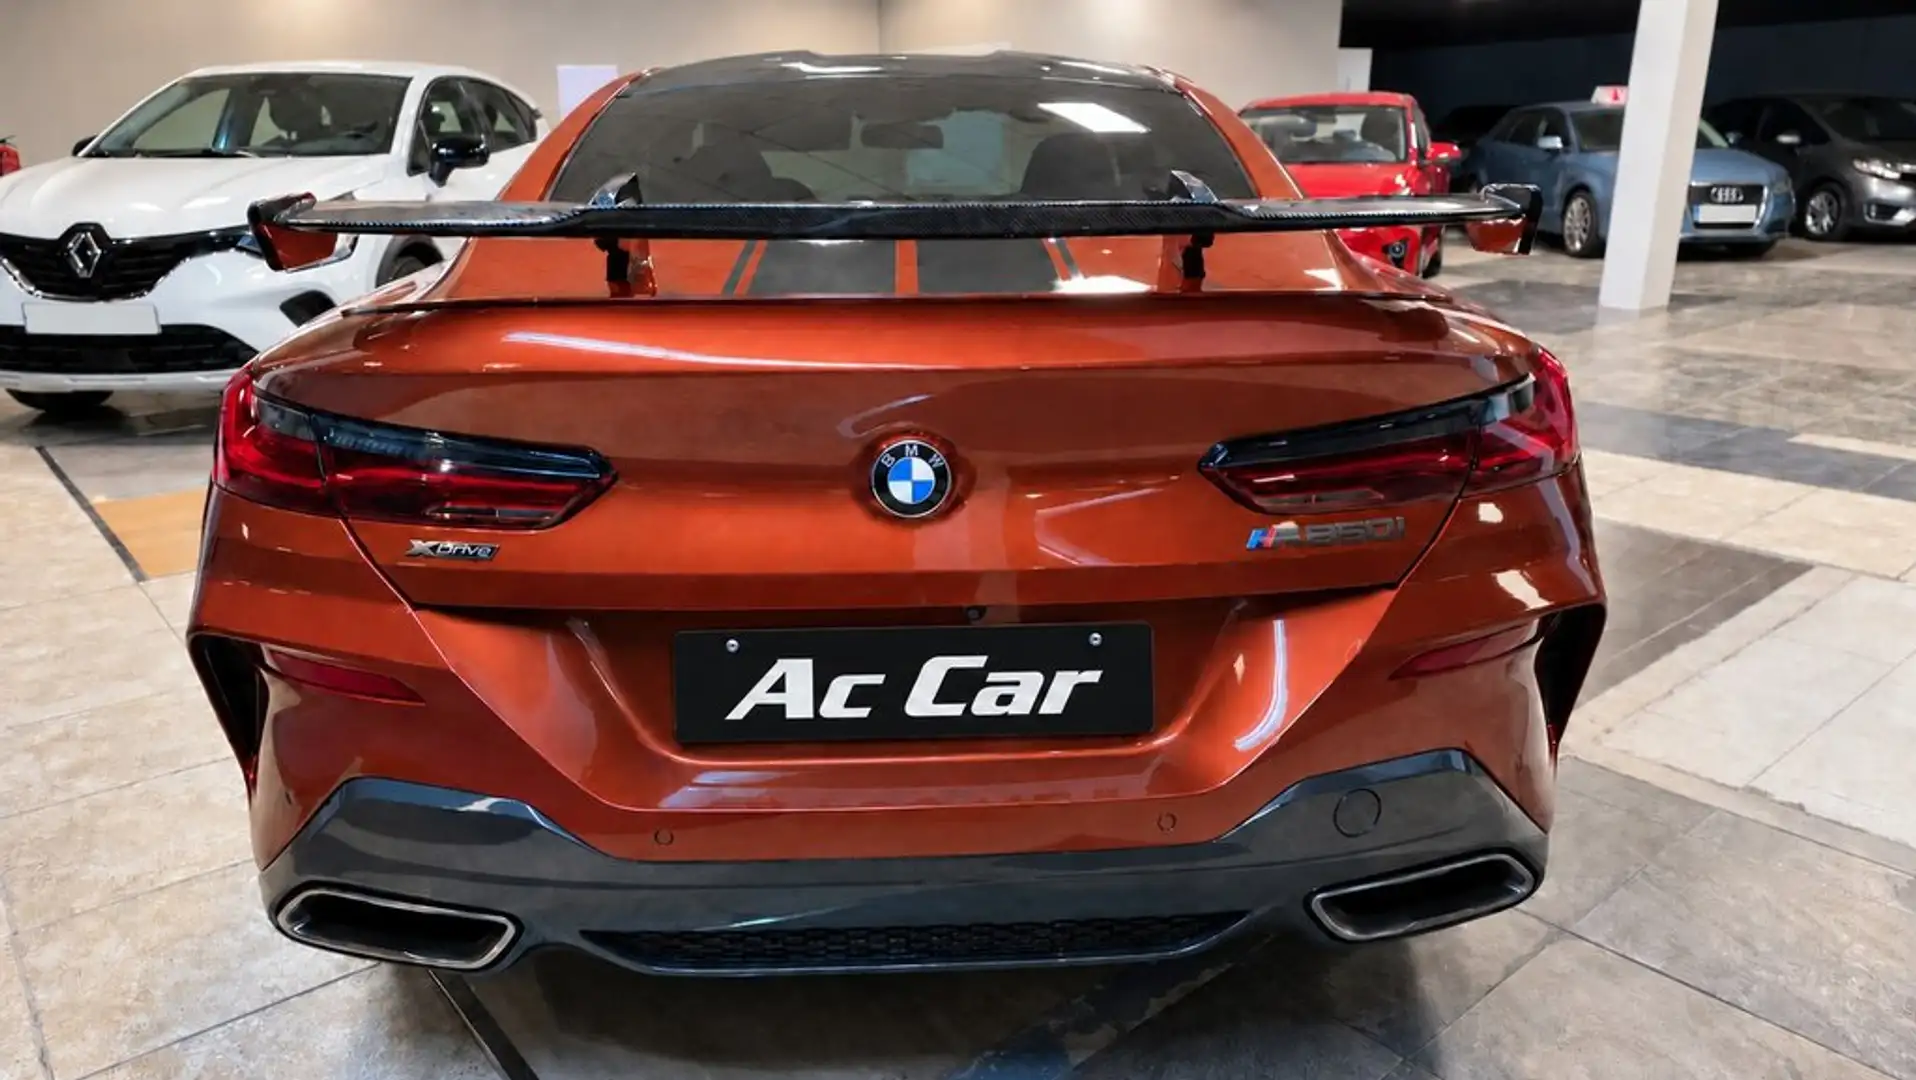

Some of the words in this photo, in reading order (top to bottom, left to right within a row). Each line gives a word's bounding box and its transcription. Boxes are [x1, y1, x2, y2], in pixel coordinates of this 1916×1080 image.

[881, 444, 945, 468] BMW
[725, 658, 886, 720] Ac
[904, 655, 1103, 717] Car
